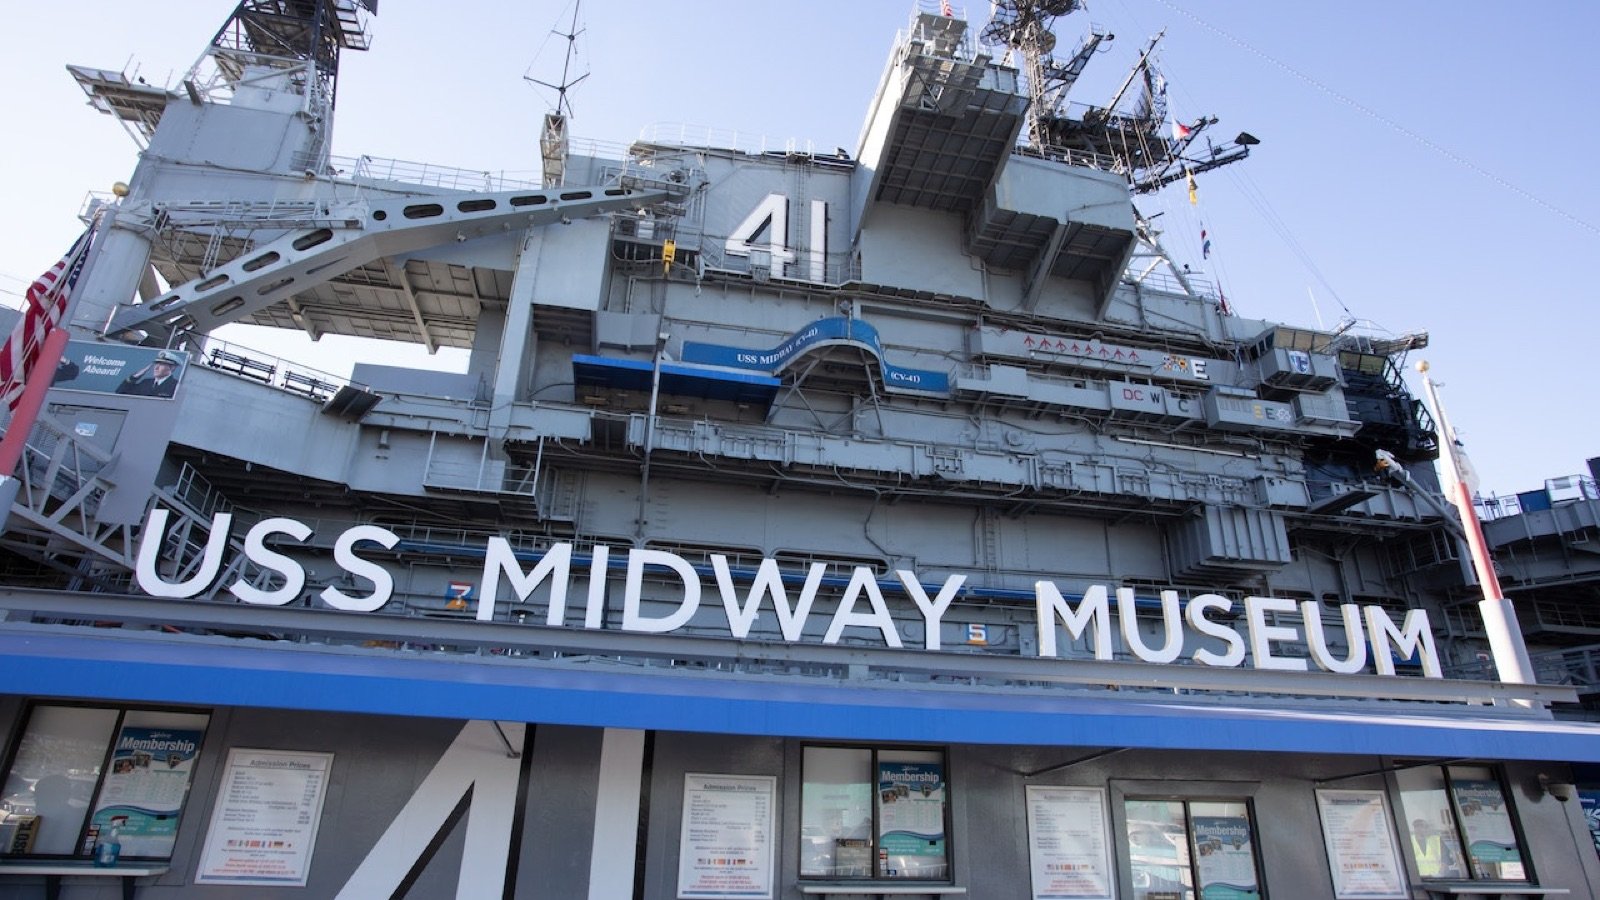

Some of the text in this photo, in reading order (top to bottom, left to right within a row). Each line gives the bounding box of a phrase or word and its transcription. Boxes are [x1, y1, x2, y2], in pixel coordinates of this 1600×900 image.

[724, 191, 828, 283] 41
[83, 354, 127, 367] Welcome
[737, 353, 757, 364] USS
[83, 365, 121, 376] Aboard!
[1190, 359, 1209, 380] E
[1122, 388, 1144, 401] DC
[135, 508, 1443, 679] USS MIDWAY MUSEUM
[968, 624, 987, 641] 5
[120, 736, 195, 755] Membership
[881, 770, 940, 785] Membership
[1195, 824, 1247, 838] Membership
